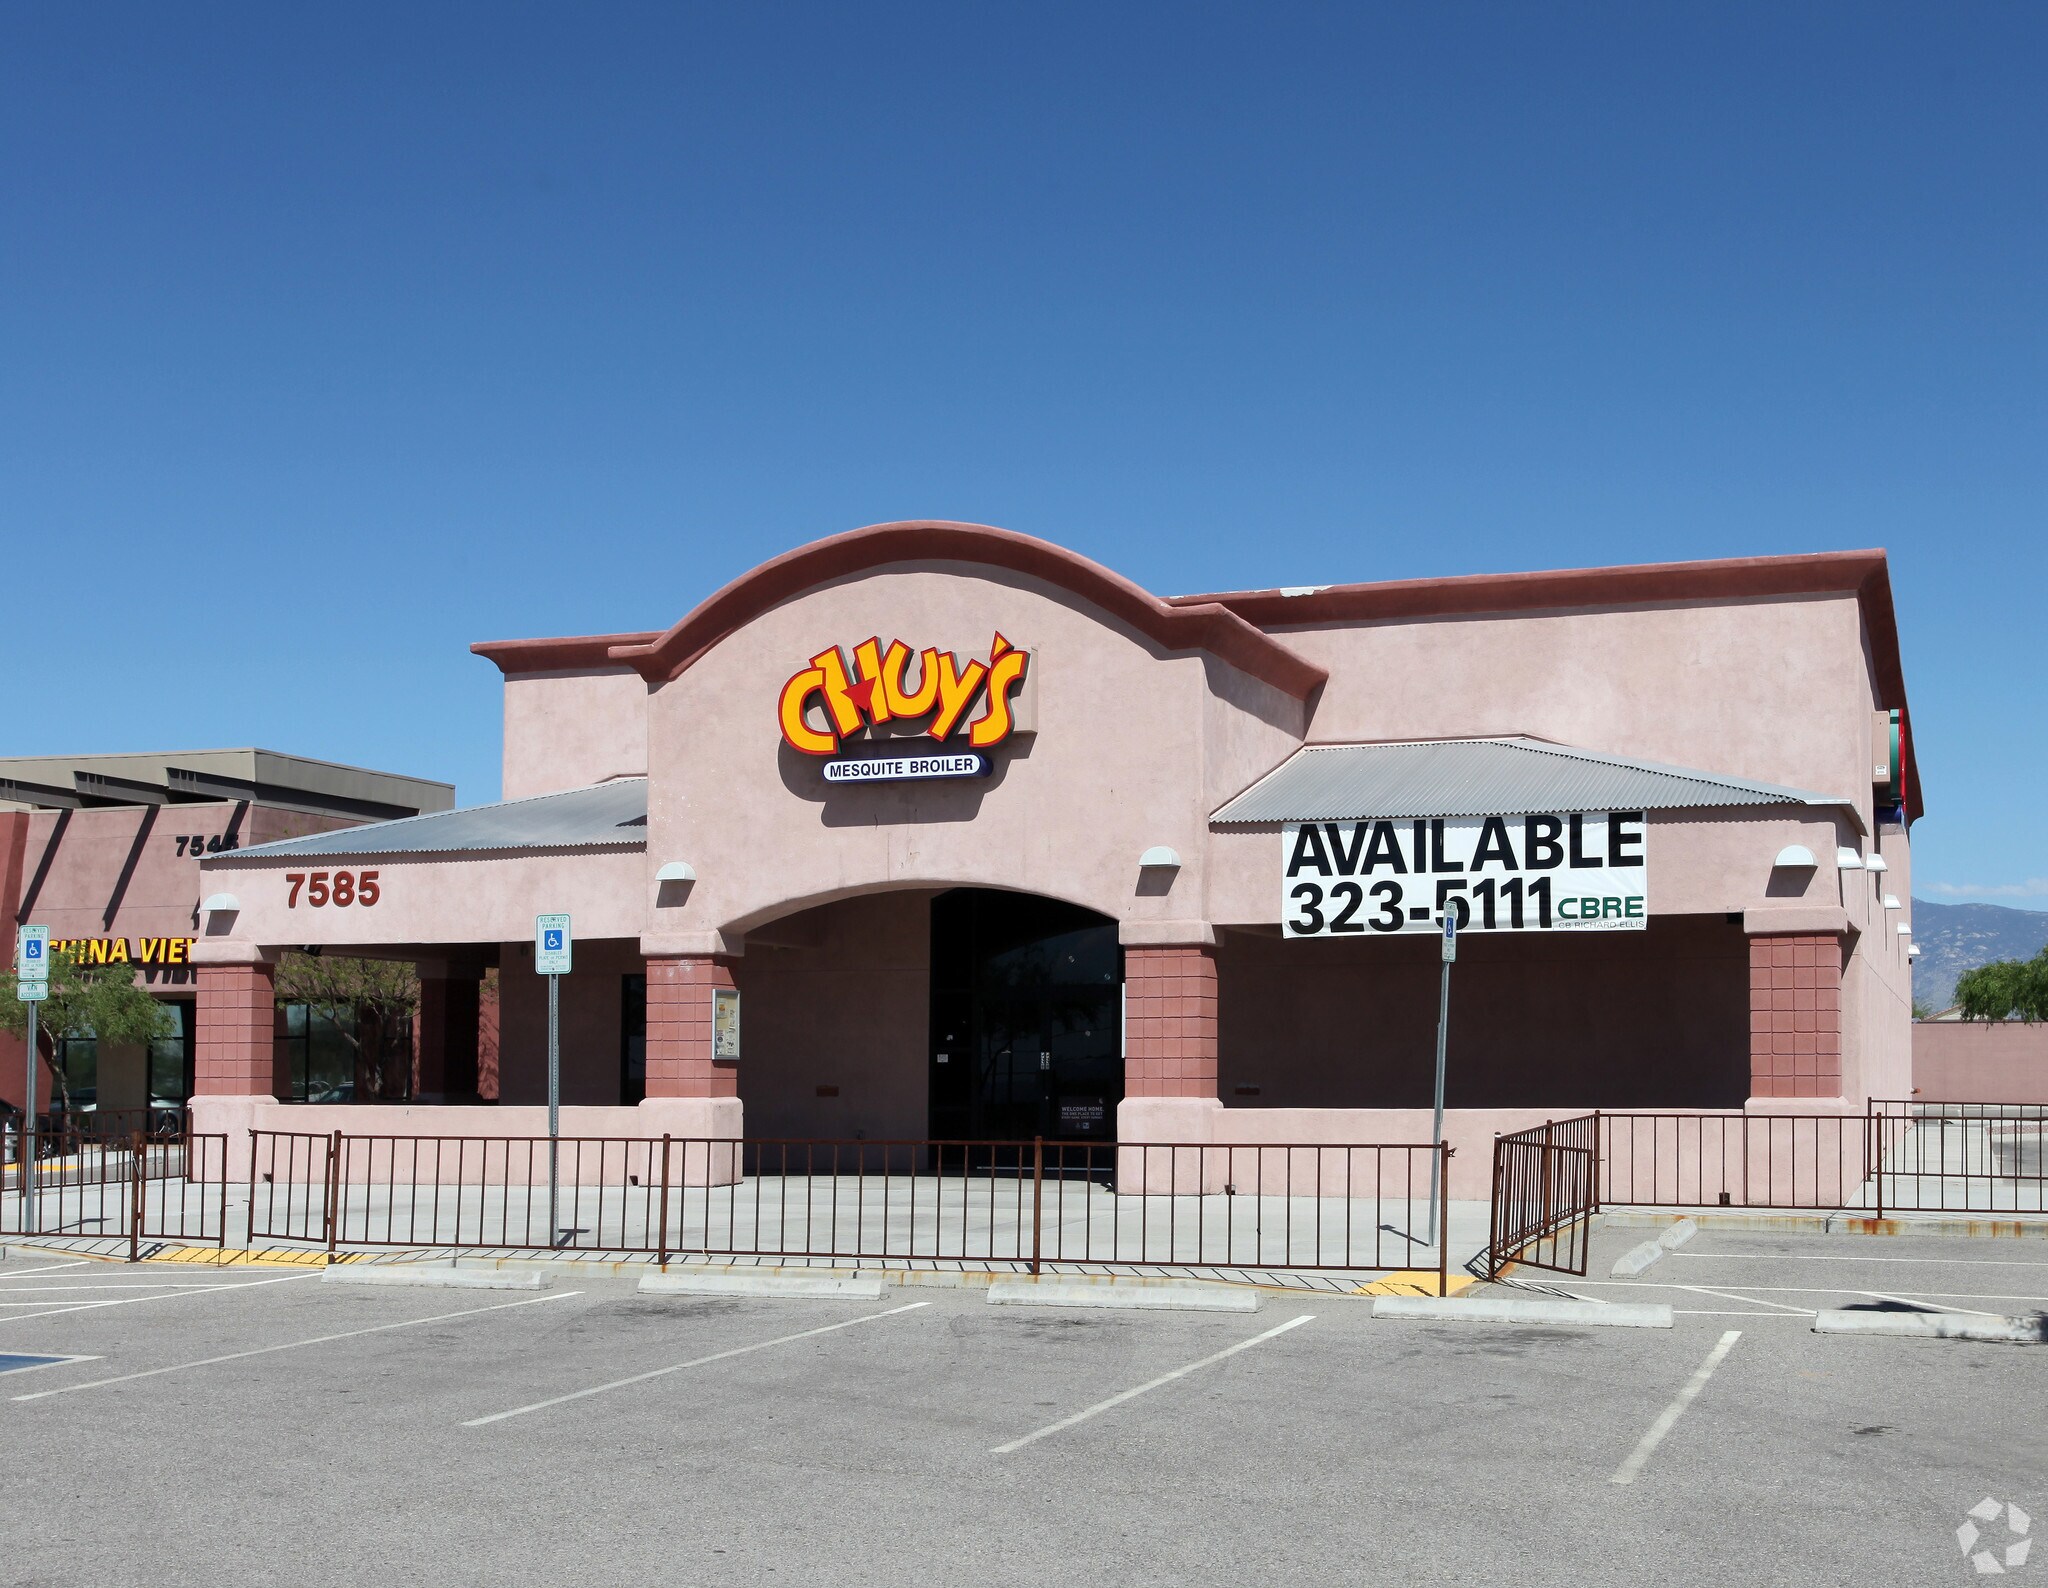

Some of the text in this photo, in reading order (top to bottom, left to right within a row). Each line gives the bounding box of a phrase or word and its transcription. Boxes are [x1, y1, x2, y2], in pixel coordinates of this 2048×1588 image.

[829, 758, 974, 778] MESQUITE BROILER
[1286, 811, 1644, 878] AVAILABLE
[286, 870, 381, 909] 7585
[1288, 876, 1553, 935] 323-5111
[1557, 896, 1644, 919] CBRE
[1558, 920, 1645, 929] CB RICHARD ELLIS
[139, 937, 199, 963] VIE
